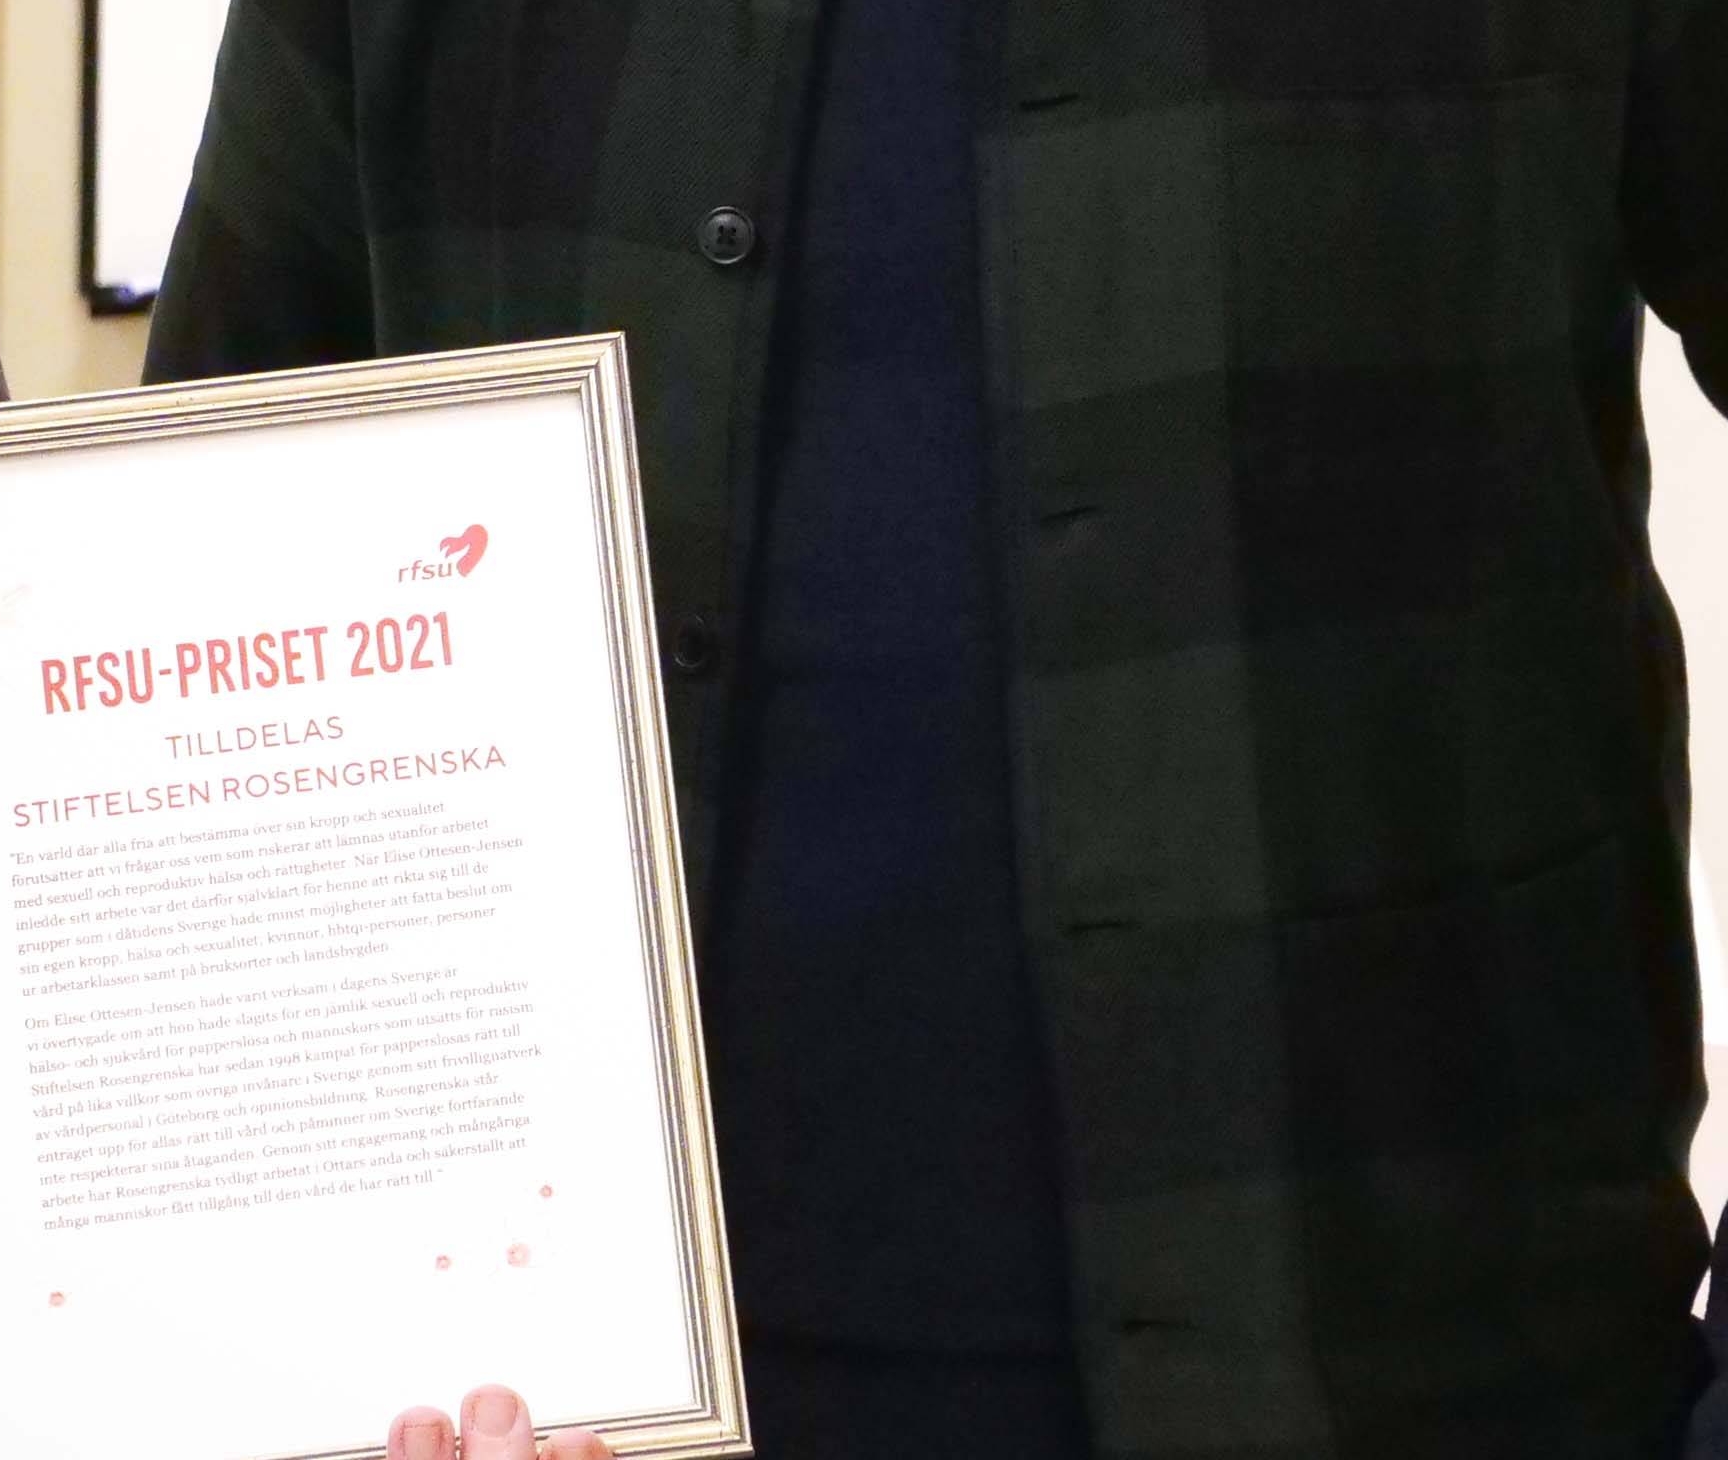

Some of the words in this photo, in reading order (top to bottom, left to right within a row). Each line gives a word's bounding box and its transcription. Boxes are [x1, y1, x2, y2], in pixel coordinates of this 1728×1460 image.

[398, 559, 453, 583] rfsu
[40, 625, 329, 715] RFSU-PRISET
[346, 611, 453, 678] 2021
[164, 715, 344, 759] TILLDELAS
[13, 780, 211, 828] STIFTELSEN
[222, 745, 506, 802] ROSENGRENSKA
[87, 866, 105, 878] att
[108, 865, 121, 875] vi
[124, 859, 166, 874] frågar
[168, 856, 191, 868] oss
[193, 853, 223, 864] vem
[225, 849, 254, 861] som
[258, 841, 311, 857] riskerar
[314, 838, 332, 850] att
[441, 819, 489, 834] arbetet
[103, 840, 127, 854] alla
[130, 837, 154, 851] fria
[157, 835, 176, 848] att
[285, 820, 306, 832] sin
[309, 815, 350, 829] kropp
[352, 808, 377, 823] och
[380, 802, 444, 820] sexualitet
[13, 893, 44, 909] med
[46, 887, 93, 906] sexuell
[96, 884, 121, 899] och
[124, 875, 205, 897] reproduktiv
[246, 865, 272, 880] och
[383, 849, 416, 864] Elise
[418, 837, 524, 859] Ottesen-Jensen
[15, 913, 66, 932] inledde
[69, 911, 91, 925] sitt
[95, 907, 138, 921] arbete
[140, 904, 163, 915] var
[166, 899, 188, 913] det
[326, 878, 368, 893] henne
[371, 875, 389, 887] att
[393, 870, 425, 885] rikta
[428, 869, 448, 882] sig
[450, 862, 469, 877] till
[472, 861, 489, 875] de
[17, 938, 71, 957] grupper
[75, 933, 104, 946] som
[115, 924, 174, 941] dåtidens
[177, 918, 227, 933] Sverige
[229, 912, 263, 926] hade
[266, 907, 305, 923] minst
[390, 895, 409, 907] att
[412, 891, 444, 904] fatta
[490, 883, 513, 895] om
[19, 964, 40, 975] sin
[43, 959, 75, 975] egen
[165, 942, 190, 957] och
[436, 907, 496, 927] personer
[22, 987, 36, 997] ur
[40, 974, 140, 995] arbetarklassen
[143, 967, 176, 982] samt
[180, 963, 197, 981] på
[199, 957, 272, 975] bruksorter
[275, 950, 300, 965] och
[24, 1017, 50, 1030] Om
[54, 1012, 86, 1027] Elise
[89, 1000, 196, 1021] Ottesen-Jensen
[199, 992, 233, 1008] hade
[271, 984, 328, 999] verksam
[340, 977, 388, 992] dagens
[391, 971, 441, 985] Sverige
[26, 1042, 39, 1052] vi
[120, 1029, 143, 1041] om
[146, 1025, 164, 1037] att
[168, 1021, 195, 1035] hon
[197, 1015, 231, 1031] hade
[235, 1012, 279, 1027] slagits
[304, 1007, 321, 1018] en
[371, 991, 418, 1009] sexuell
[421, 987, 446, 1003] och
[449, 980, 529, 1002] reproduktiv
[74, 1053, 99, 1069] och
[102, 1045, 161, 1068] sjukvård
[273, 1029, 297, 1044] och
[383, 1018, 413, 1030] som
[30, 1079, 95, 1097] Stiftelsen
[99, 1065, 194, 1088] Rosengrenska
[198, 1062, 220, 1076] har
[224, 1056, 265, 1073] sedan
[268, 1051, 301, 1069] 1998
[501, 1022, 521, 1038] till
[32, 1102, 64, 1118] vård
[67, 1100, 84, 1118] på
[87, 1098, 113, 1112] lika
[115, 1092, 161, 1108] villkor
[163, 1091, 193, 1102] som
[242, 1076, 302, 1093] invånare
[313, 1069, 363, 1084] Sverige
[367, 1063, 413, 1080] genom
[416, 1059, 438, 1070] sitt
[35, 1130, 51, 1141] av
[53, 1115, 144, 1139] vårdpersonal
[222, 1102, 247, 1117] och
[375, 1075, 470, 1099] Rosengrenska
[473, 1071, 499, 1086] står
[98, 1144, 125, 1159] upp
[151, 1134, 183, 1149] allas
[213, 1126, 233, 1141] till
[236, 1122, 268, 1138] vård
[271, 1118, 296, 1134] och
[299, 1114, 366, 1134] påminner
[369, 1110, 391, 1122] om
[394, 1104, 444, 1118] Sverige
[448, 1091, 525, 1113] fortfarande
[39, 1173, 66, 1186] inte
[70, 1163, 149, 1183] respekterar
[262, 1143, 312, 1158] Genom
[315, 1139, 337, 1152] sitt
[340, 1128, 428, 1149] engagemang
[430, 1122, 454, 1137] och
[458, 1115, 530, 1133] mångåriga
[41, 1193, 85, 1209] arbete
[87, 1189, 112, 1202] har
[115, 1176, 212, 1199] Rosengrenska
[215, 1171, 258, 1186] tydligt
[263, 1164, 311, 1181] arbetat
[322, 1158, 366, 1173] Ottars
[370, 1151, 403, 1167] anda
[406, 1147, 431, 1162] och
[508, 1137, 526, 1150] att
[43, 1215, 90, 1231] många
[171, 1201, 194, 1215] fått
[198, 1195, 250, 1212] tillgång
[253, 1188, 272, 1205] till
[275, 1188, 301, 1203] den
[305, 1181, 336, 1197] vård
[339, 1179, 355, 1194] de
[359, 1177, 382, 1191] har
